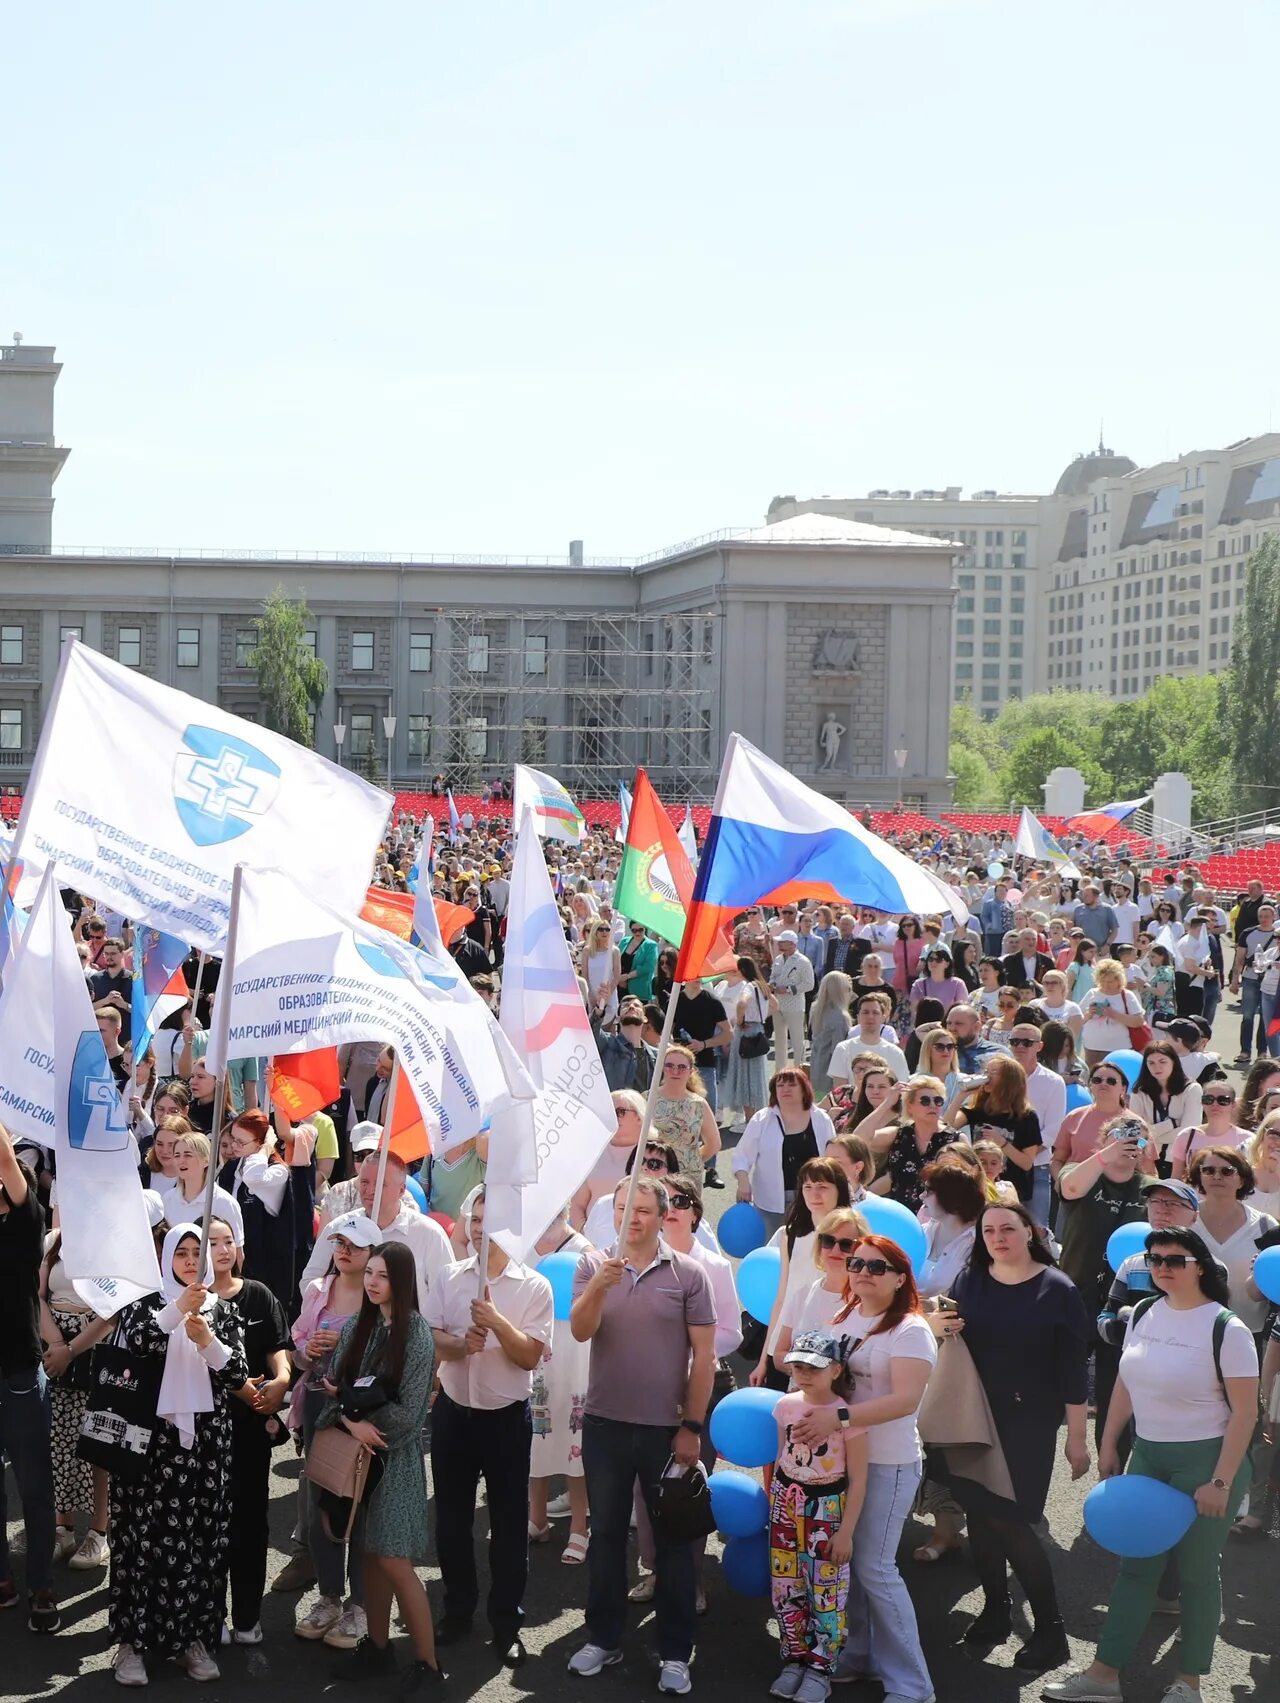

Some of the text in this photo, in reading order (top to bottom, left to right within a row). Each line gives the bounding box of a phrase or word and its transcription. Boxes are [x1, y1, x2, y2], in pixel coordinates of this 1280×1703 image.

[54, 799, 148, 856] ГОСУДАРСТВЕННОЕ
[149, 847, 216, 887] БЮДЖЕТНОЕ
[96, 845, 194, 901] ОБРАЗОВАТЕЛЬНОЕ
[278, 990, 438, 1065] ОБРАЗОВАТЕЛЬНОЕ УЧРЕЖДЕНИЕ
[327, 975, 400, 1005] БЮДЖЕТНОЕ
[401, 1001, 481, 1113] ПРОФЕССИОНАЛЬНОЕ
[283, 1008, 353, 1036] МЕДИЦИНСКИЙ
[353, 1011, 406, 1043] КОЛЛЕДЖ
[419, 1081, 455, 1143] ЛЯПИНОЙ»
